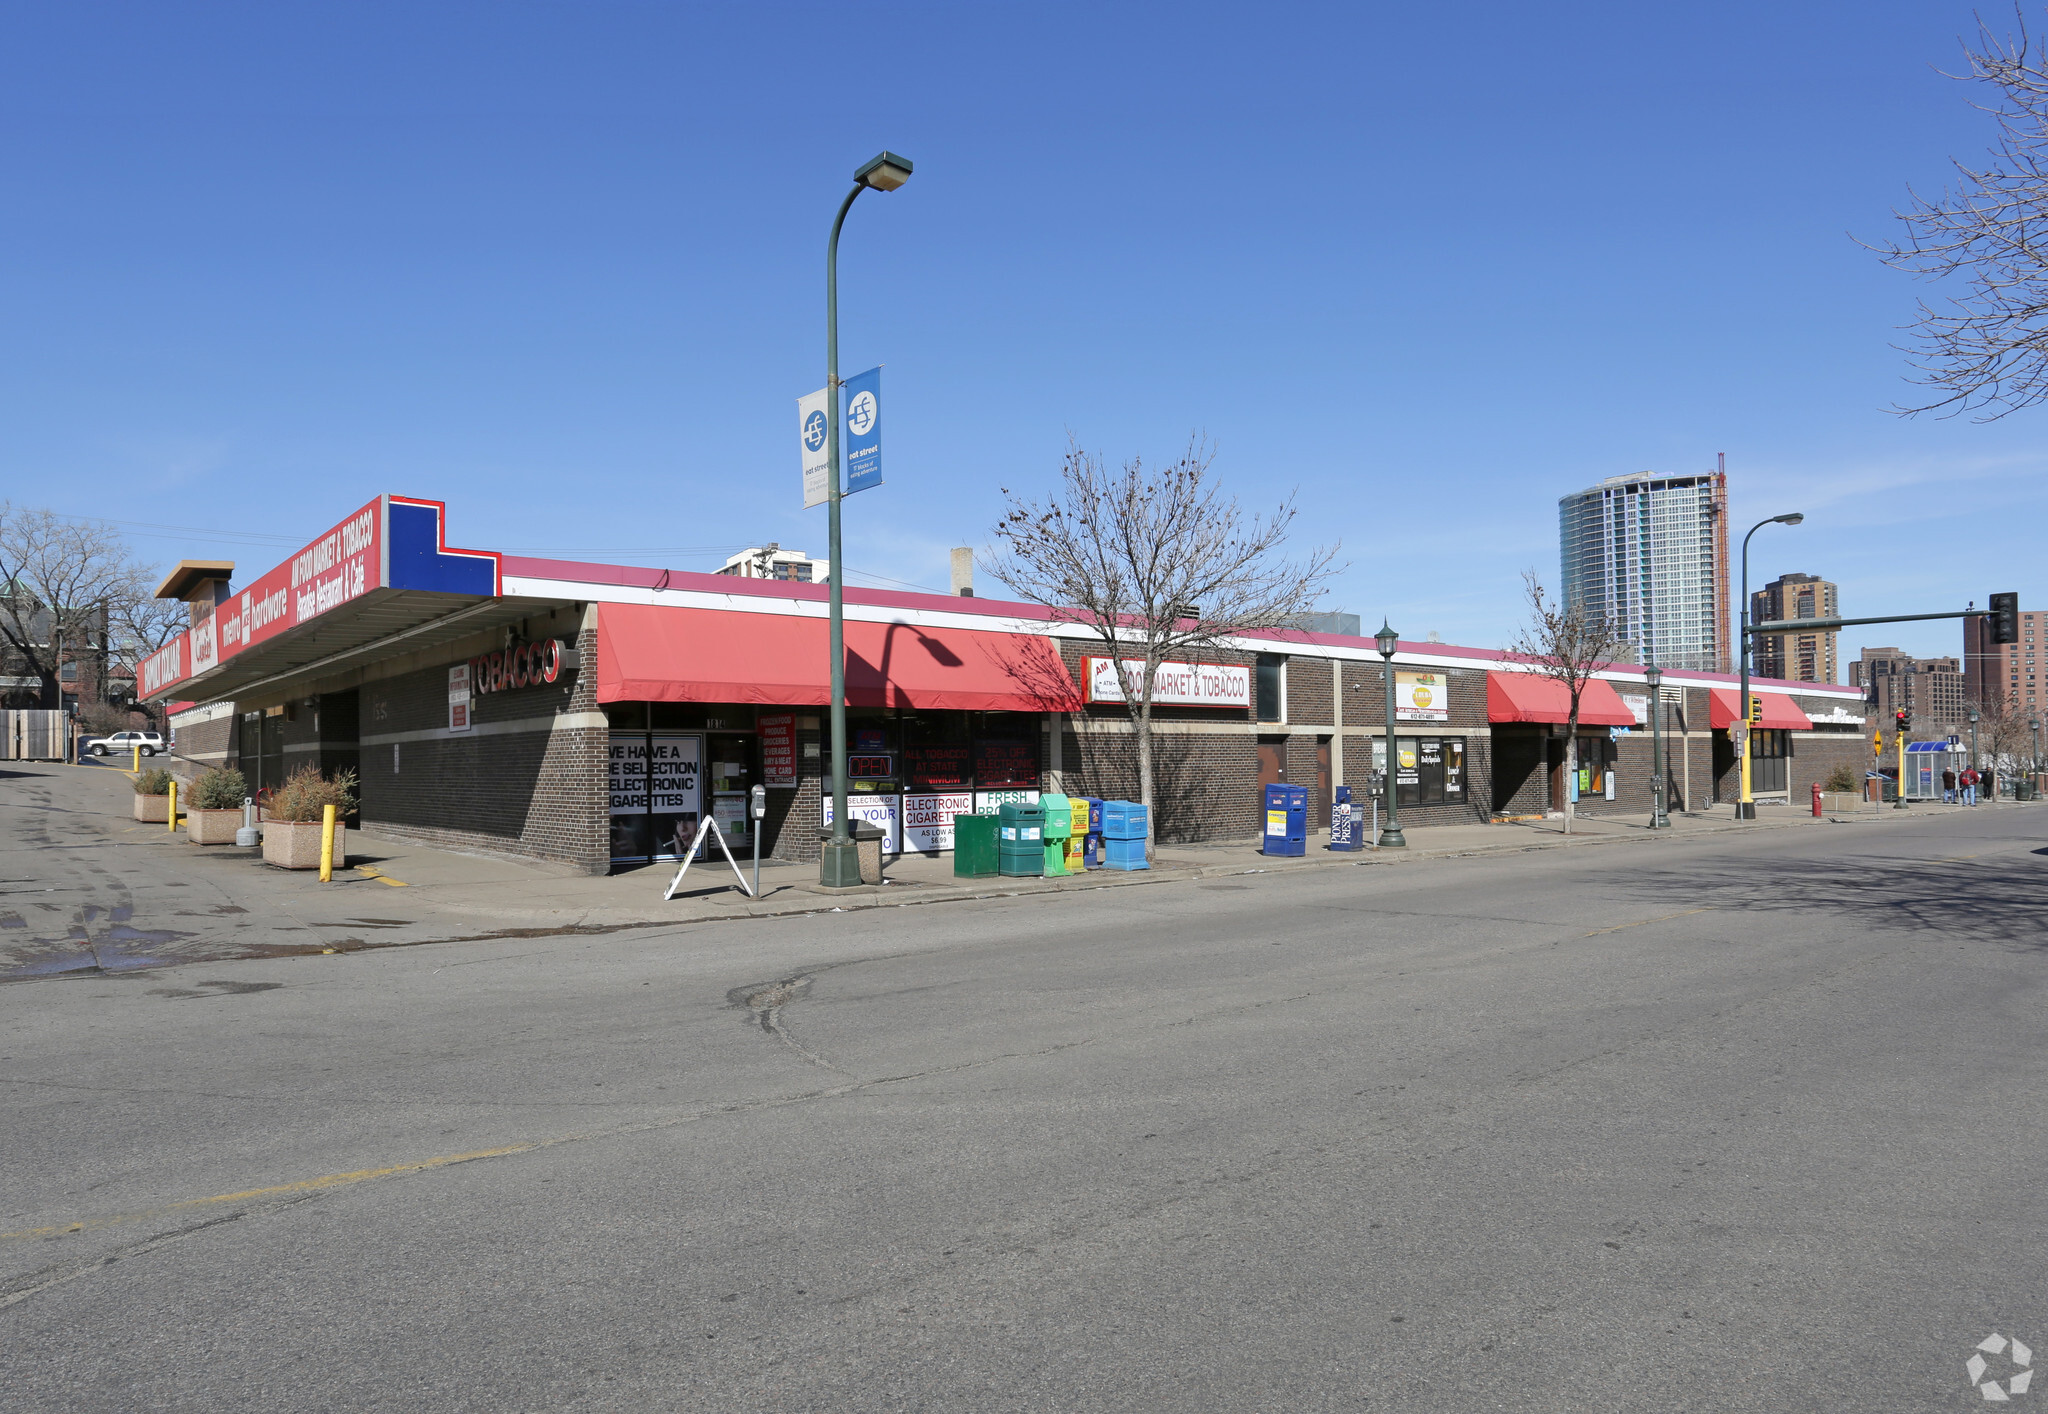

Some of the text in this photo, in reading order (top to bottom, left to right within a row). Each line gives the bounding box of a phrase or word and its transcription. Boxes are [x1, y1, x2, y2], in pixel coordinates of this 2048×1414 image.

[848, 444, 878, 460] eat street
[805, 467, 814, 476] eat
[860, 466, 878, 475] adventure
[300, 549, 313, 585] FOOD
[313, 533, 336, 577] MARKET
[336, 530, 342, 564] &
[342, 508, 373, 559] TOBACCO
[296, 584, 316, 623] Paradise
[316, 567, 344, 614] Restaurant
[344, 563, 350, 600] &
[222, 612, 241, 648] metro
[251, 587, 287, 632] hardware
[468, 638, 561, 695] TOBACCO
[1096, 661, 1109, 676] AM
[1152, 672, 1192, 696] MARKET
[1194, 673, 1200, 697] &
[1203, 675, 1245, 698] TOBACCO
[779, 716, 791, 725] FOOD
[764, 727, 787, 735] PRODUCE
[763, 737, 789, 746] GROCERIES
[627, 745, 668, 759] HAVE
[670, 745, 681, 759] A
[904, 749, 969, 760] ALL TOBACCO
[985, 747, 1027, 758] 25% OFF
[779, 757, 791, 765] MEAT
[850, 758, 891, 776] OPEN
[915, 762, 958, 772] AT STATE
[977, 759, 1036, 769] ELECTRONIC
[622, 762, 698, 775] SELECTION
[778, 766, 792, 775] CARD
[912, 774, 961, 785] MINIMUM
[977, 770, 1036, 780] CIGARETTES
[609, 777, 694, 792] ELECTRONIC
[987, 791, 1028, 804] FRESH
[905, 797, 970, 811] ELECTRONIC
[862, 808, 896, 821] YOUR
[1330, 804, 1342, 844] PIONEER
[1340, 815, 1351, 844] PRESS
[921, 829, 931, 837] AS
[931, 836, 947, 844] $6.99
